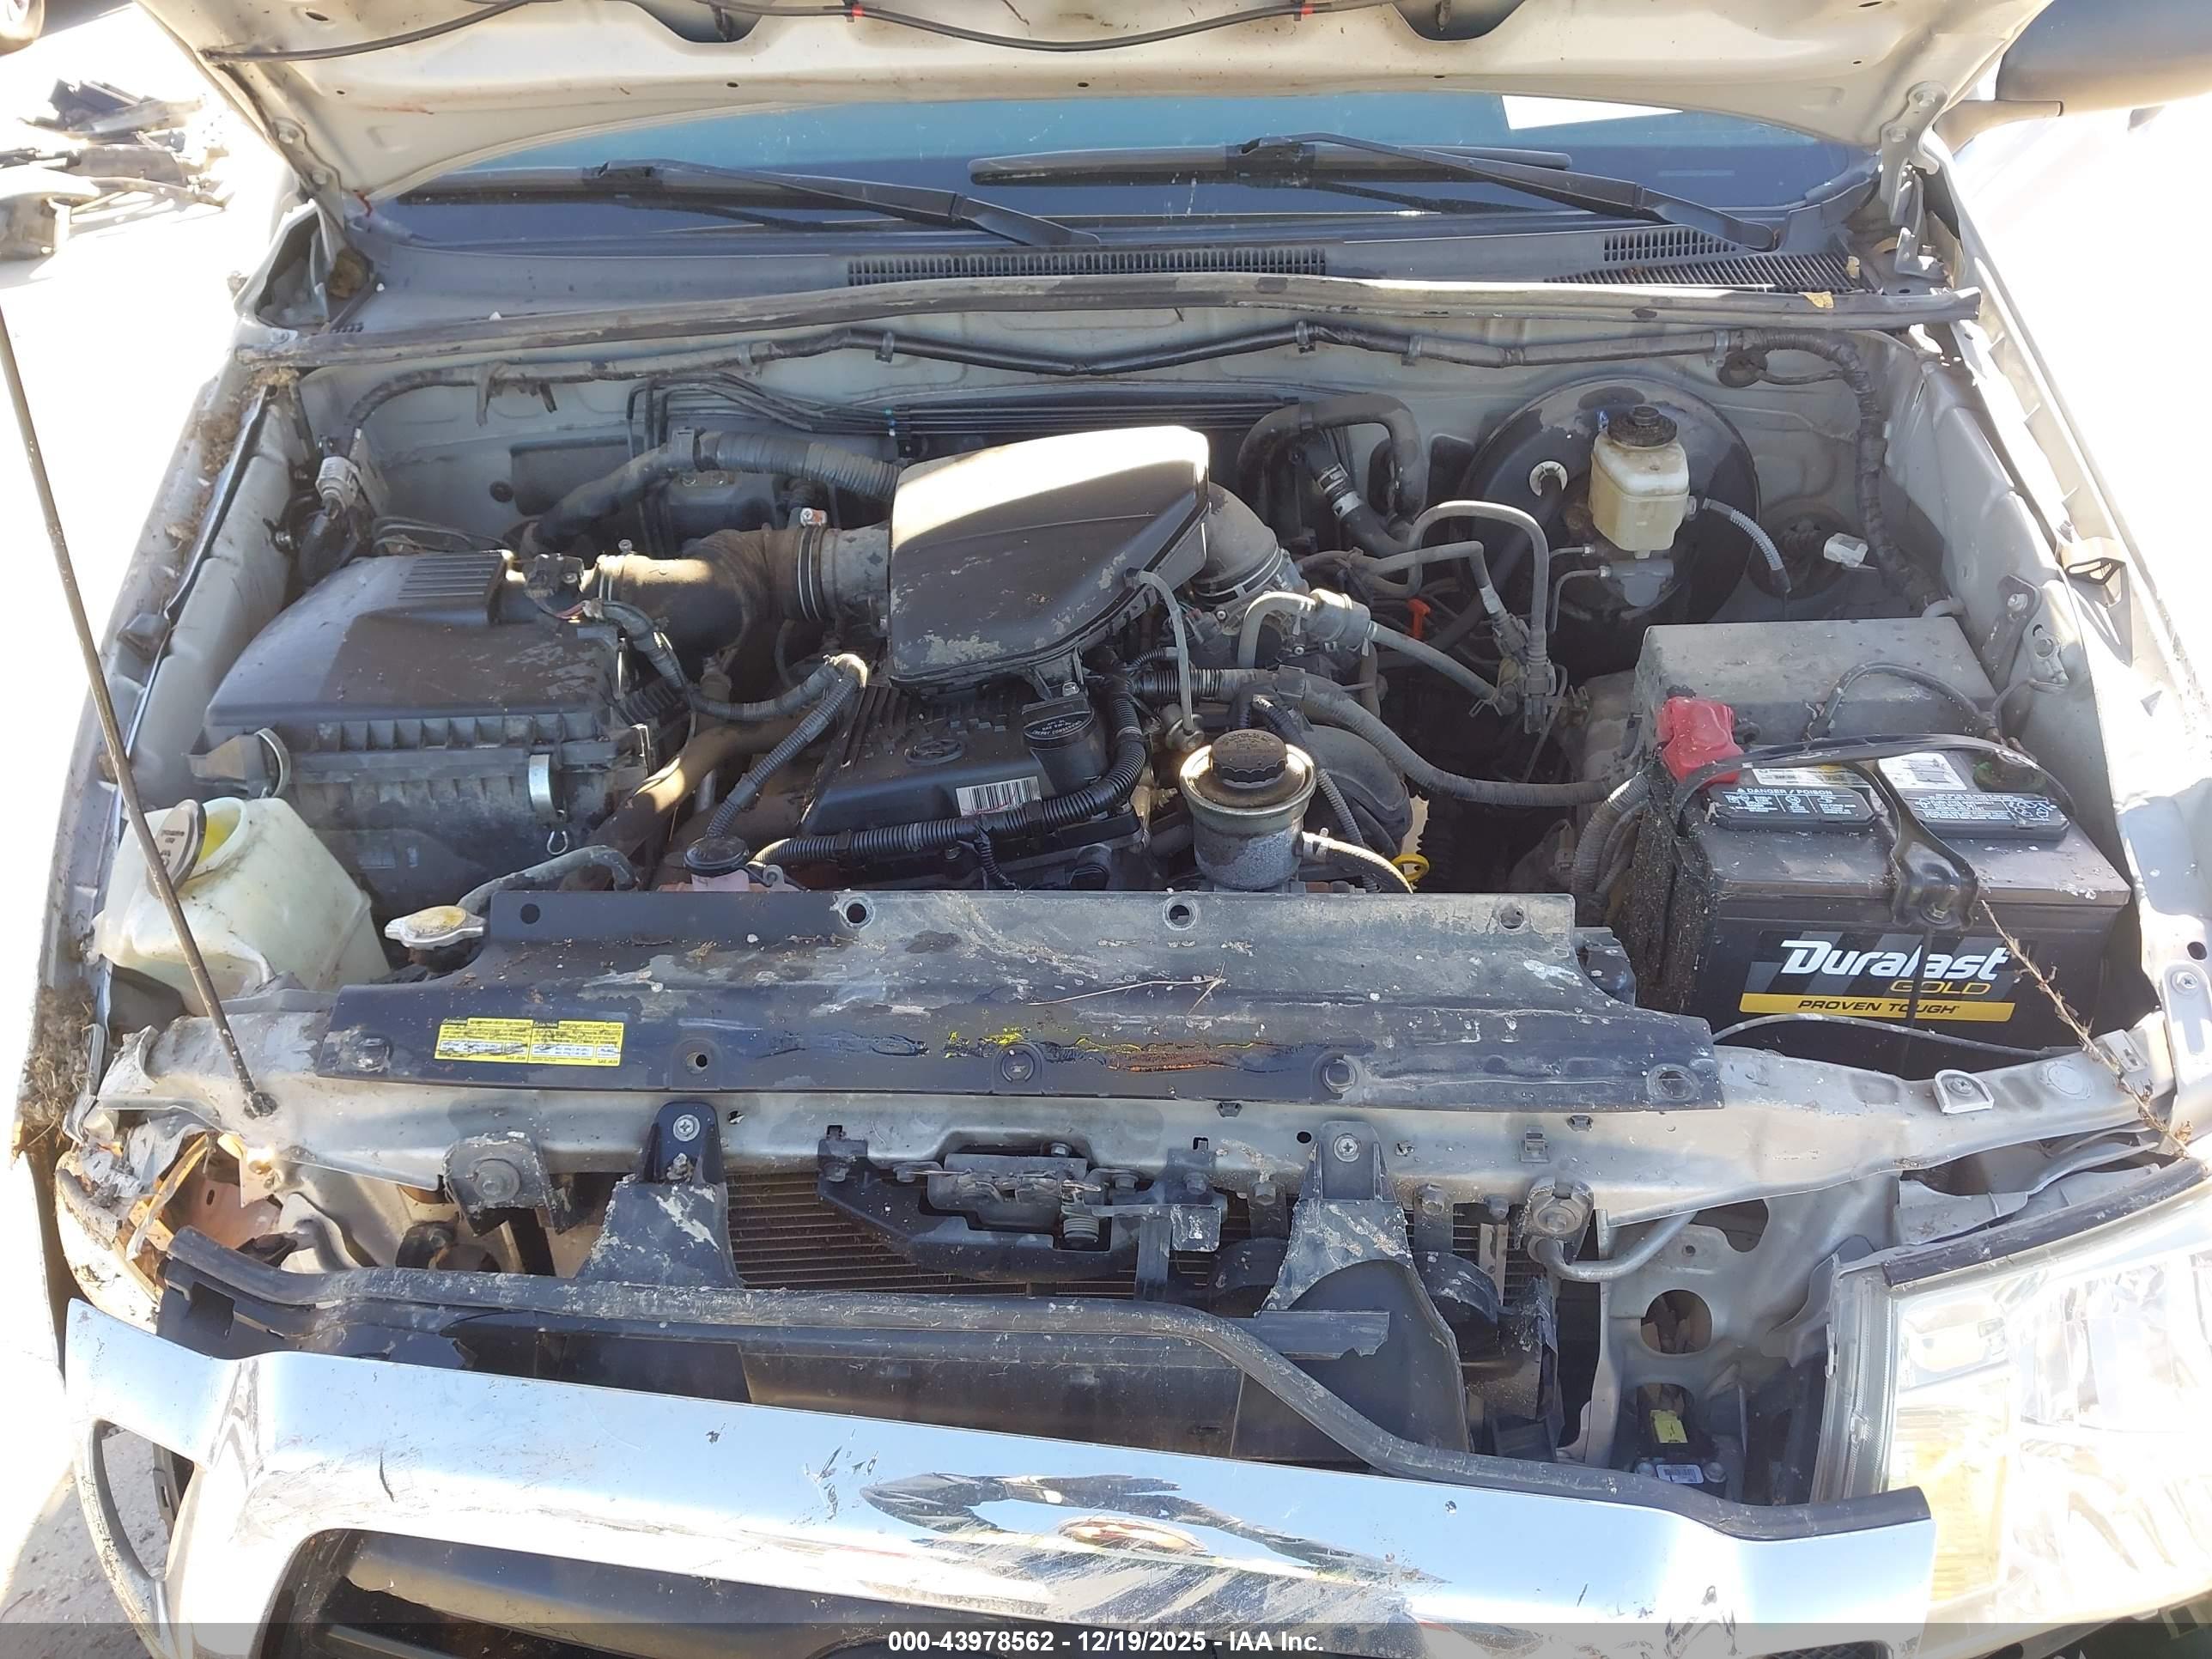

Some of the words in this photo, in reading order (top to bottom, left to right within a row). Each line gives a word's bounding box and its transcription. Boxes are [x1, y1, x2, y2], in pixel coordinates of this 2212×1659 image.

[1780, 940, 2009, 981] Duralast
[1890, 980, 1991, 995] GOLD
[1797, 1000, 1883, 1012] PROVEN
